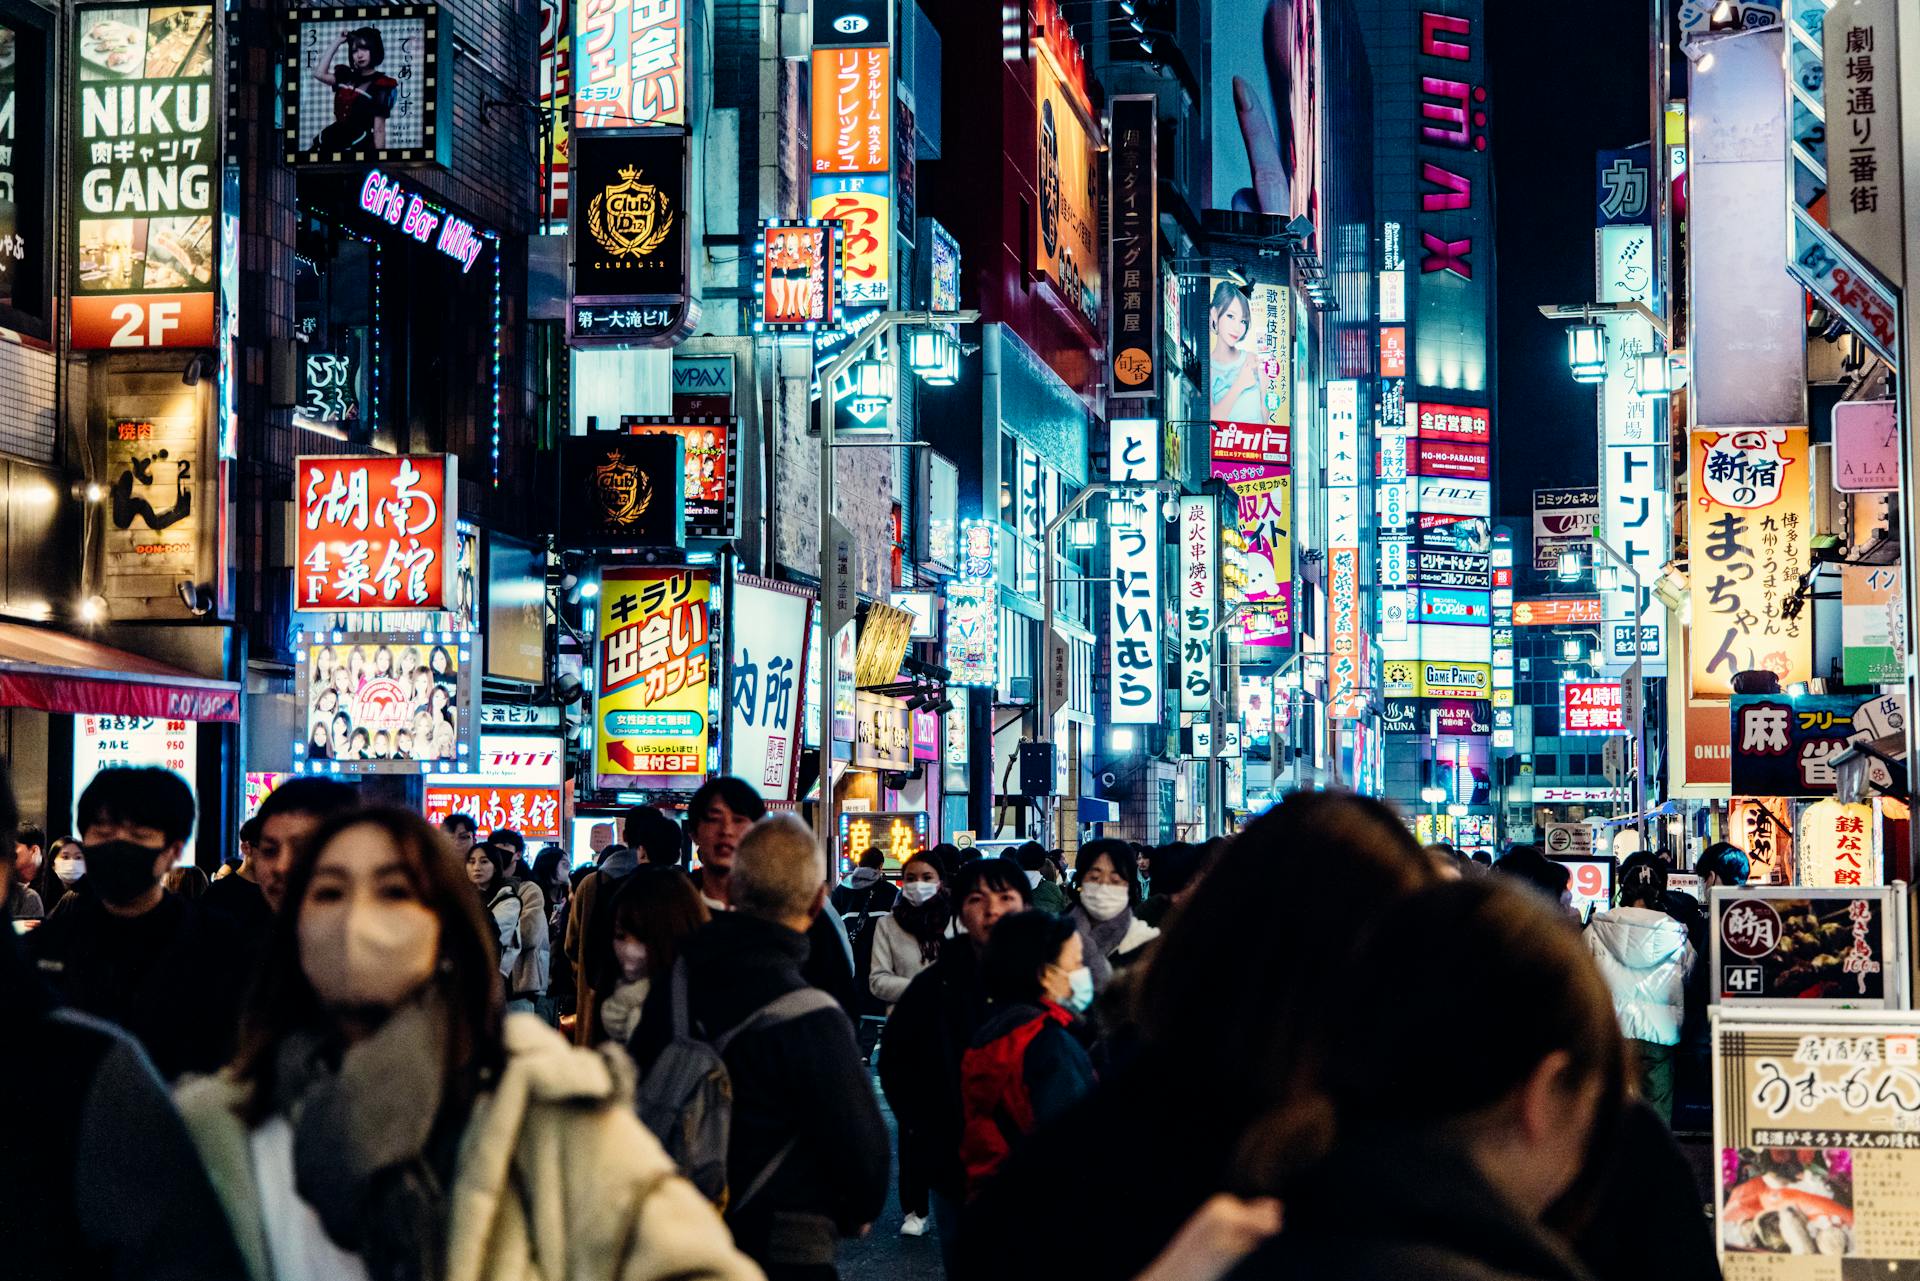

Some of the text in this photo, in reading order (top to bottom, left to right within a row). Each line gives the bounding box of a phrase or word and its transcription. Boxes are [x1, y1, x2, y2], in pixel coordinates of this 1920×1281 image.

[843, 19, 860, 30] 3F
[580, 86, 622, 100] キラリ
[867, 51, 882, 164] レンタルルーム ホステル
[81, 85, 211, 138] NIKU
[582, 105, 616, 127] 1F
[837, 52, 861, 170] リフレッシュ
[1845, 26, 1879, 214] 劇場通り一番街
[815, 160, 831, 170] 2F
[81, 164, 211, 213] GANG
[839, 179, 865, 193] 1F
[360, 168, 483, 274] Girls Bar Milky
[109, 302, 182, 348] 2F
[856, 403, 874, 413] B1
[1420, 412, 1486, 435] 全店営業中
[118, 422, 153, 441] 焼肉
[1214, 423, 1288, 453] ポケパラ
[1382, 448, 1394, 478] の鉄人
[1394, 435, 1405, 478] カラオケ
[1707, 450, 1780, 489] 新宿
[1863, 463, 1886, 475] LA
[306, 459, 438, 537] 湖南
[1236, 477, 1289, 495] 今すぐ見つかる
[1421, 486, 1489, 501] FACE
[1537, 492, 1600, 506] コミック&ネッ
[1732, 487, 1756, 505] の
[1388, 487, 1400, 525] GiGO
[1188, 504, 1208, 598] 炭火串焼き
[1388, 543, 1400, 582] GiGO
[1333, 550, 1354, 634] 横浜家系
[1759, 514, 1781, 636] 九州のうまかもん
[610, 570, 694, 623] キラリ
[1705, 512, 1759, 675] まっちゃん
[606, 603, 704, 687] 出会い
[1184, 605, 1211, 697] ちから
[643, 653, 707, 709] カフェ
[1570, 708, 1622, 727] 営業中
[1742, 707, 1788, 751] 麻
[1798, 712, 1852, 730] フリー
[97, 740, 185, 750] カルビ 950
[632, 754, 698, 772] 受付3F
[1544, 789, 1582, 801] コーヒー
[1727, 968, 1760, 991] 4F
